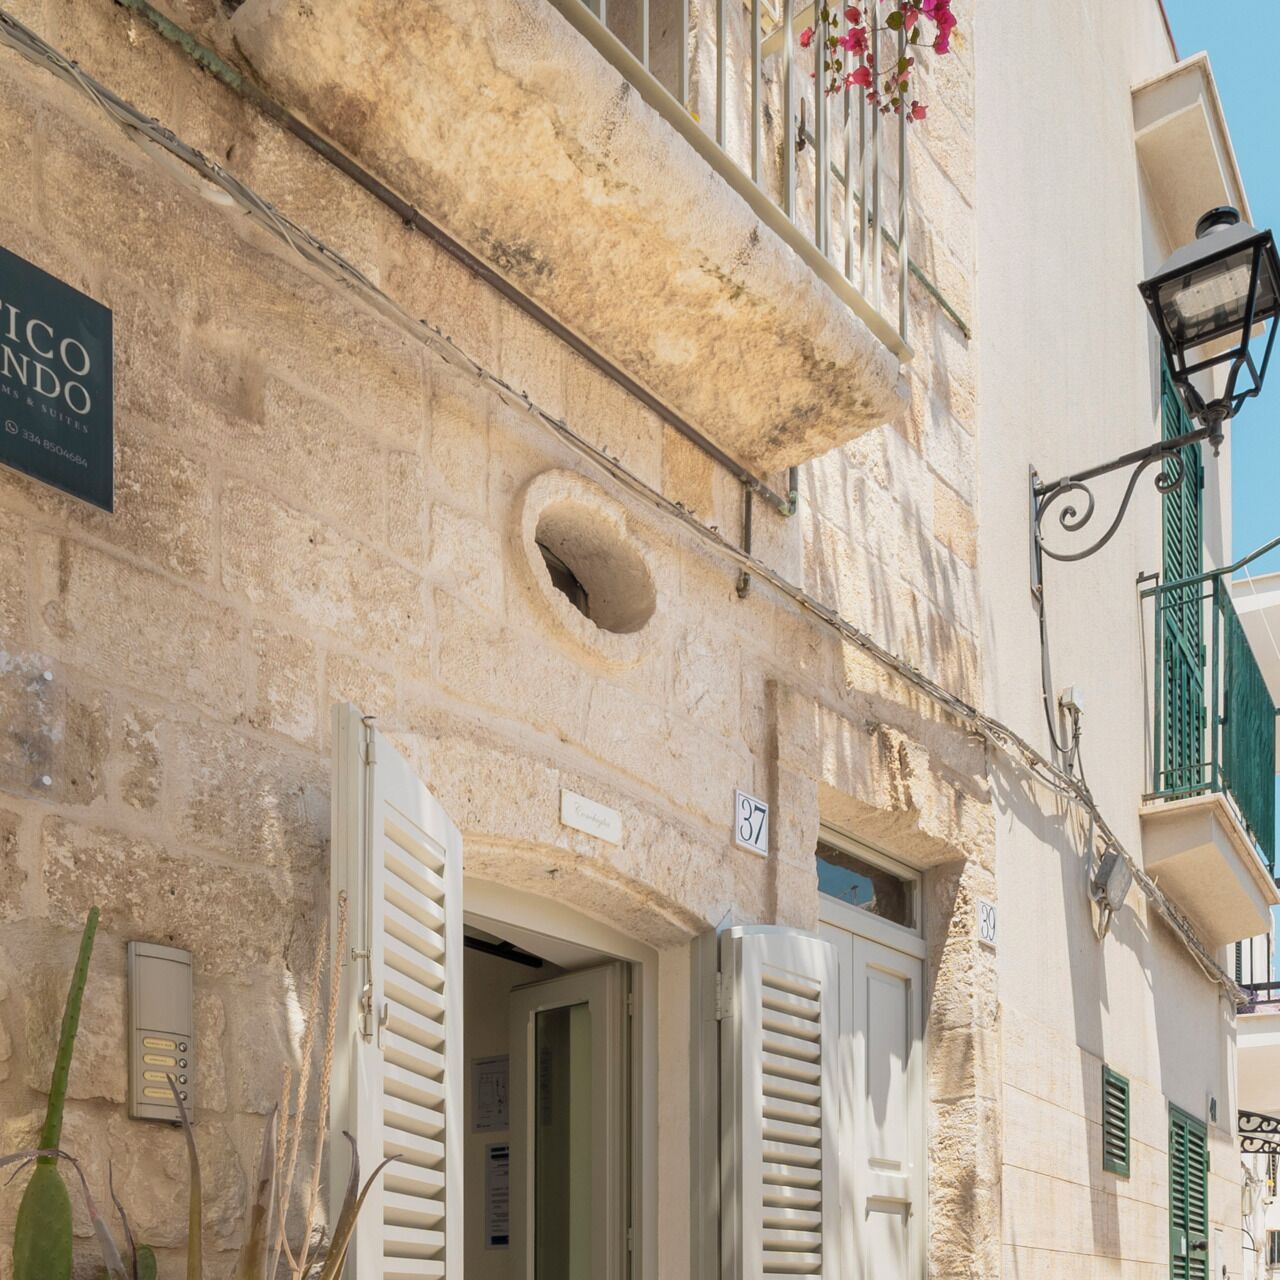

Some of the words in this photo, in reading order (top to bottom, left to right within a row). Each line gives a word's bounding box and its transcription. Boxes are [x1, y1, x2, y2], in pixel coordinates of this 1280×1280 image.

[26, 397, 35, 407] &
[41, 404, 88, 433] SUITES
[22, 429, 41, 445] 334
[740, 798, 767, 846] 37
[980, 902, 996, 941] 39
